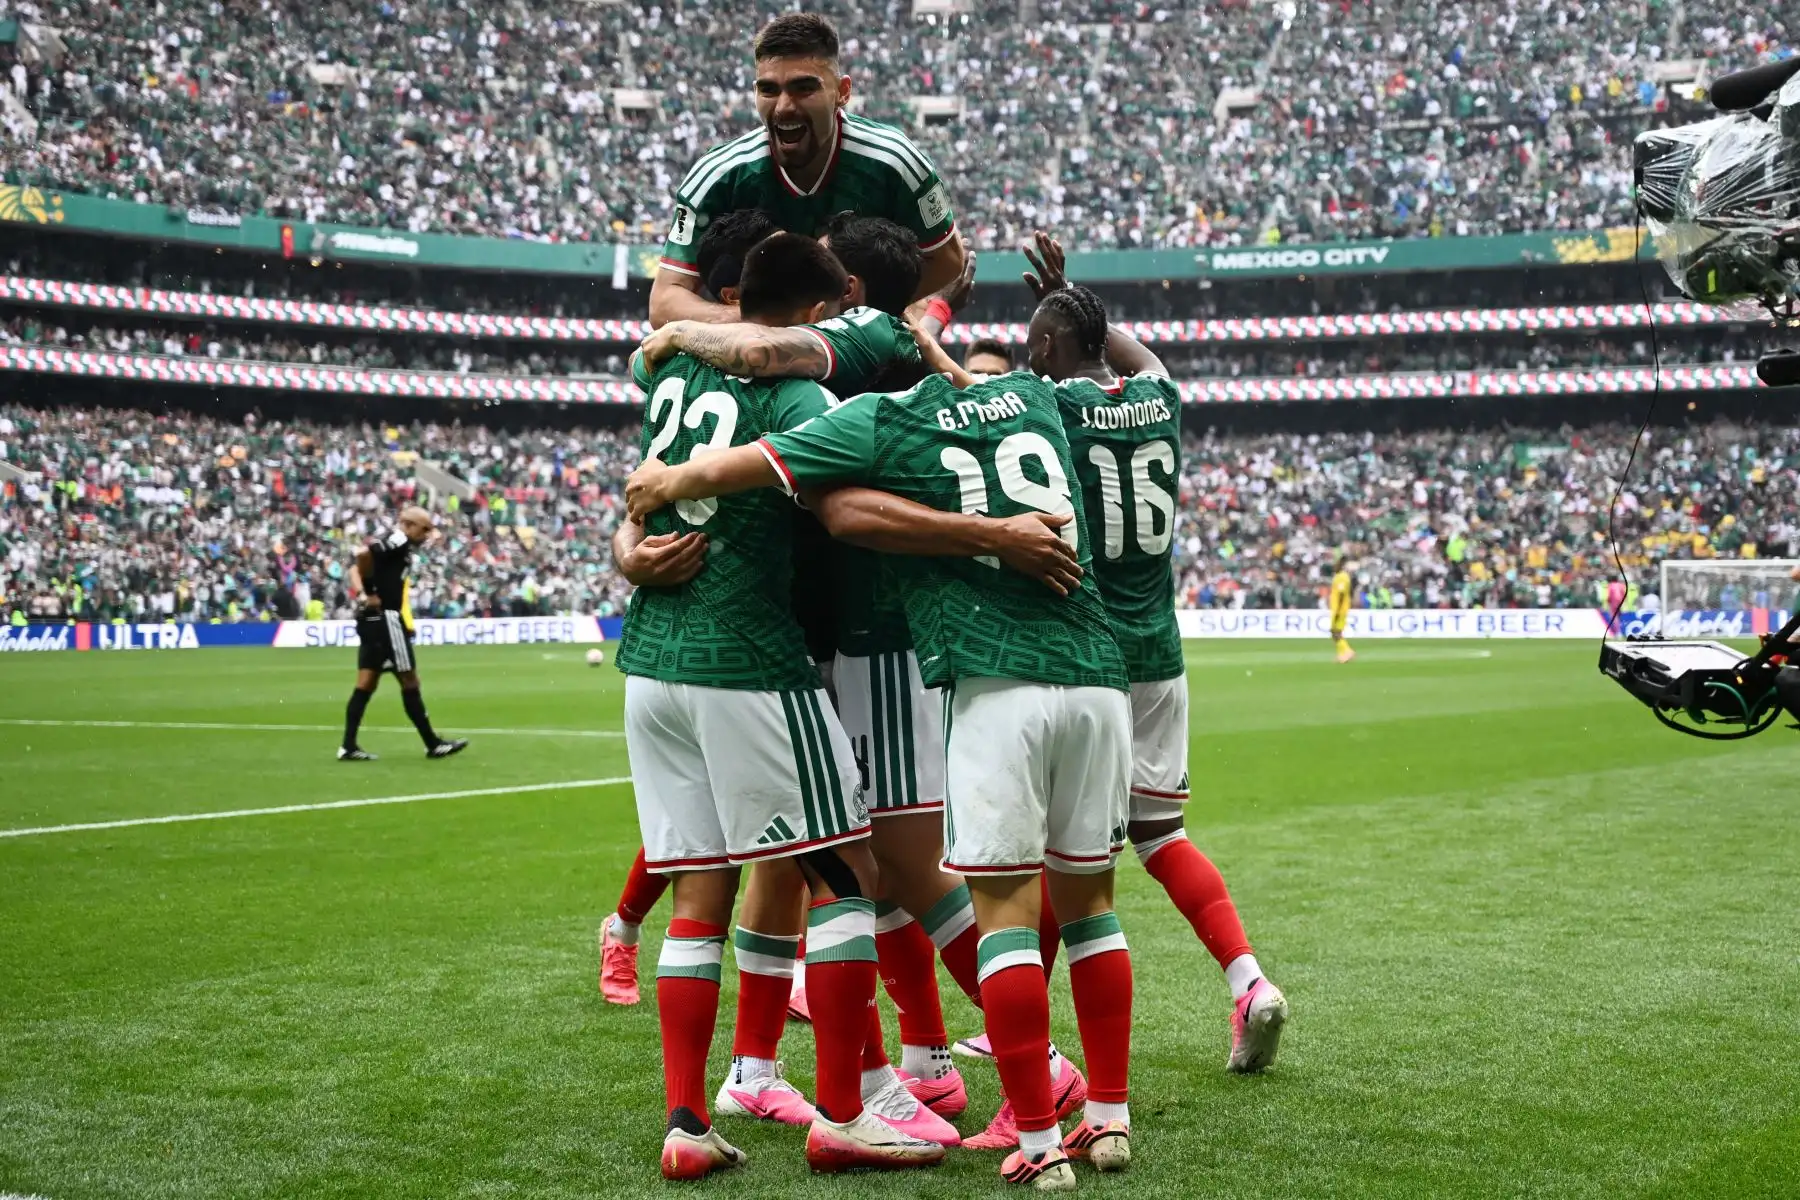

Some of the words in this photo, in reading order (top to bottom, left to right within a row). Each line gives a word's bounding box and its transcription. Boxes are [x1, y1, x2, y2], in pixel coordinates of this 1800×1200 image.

[1212, 250, 1320, 270] MEXICO
[1324, 246, 1389, 265] CITY
[936, 391, 1028, 431] G.MORA
[940, 431, 1079, 570] 19
[1088, 439, 1175, 560] 16
[100, 623, 200, 650] ULTRA
[441, 624, 512, 645] LIGHT
[518, 620, 575, 642] BEER
[1369, 613, 1467, 633] LIGHT
[1477, 613, 1565, 633] BEER
